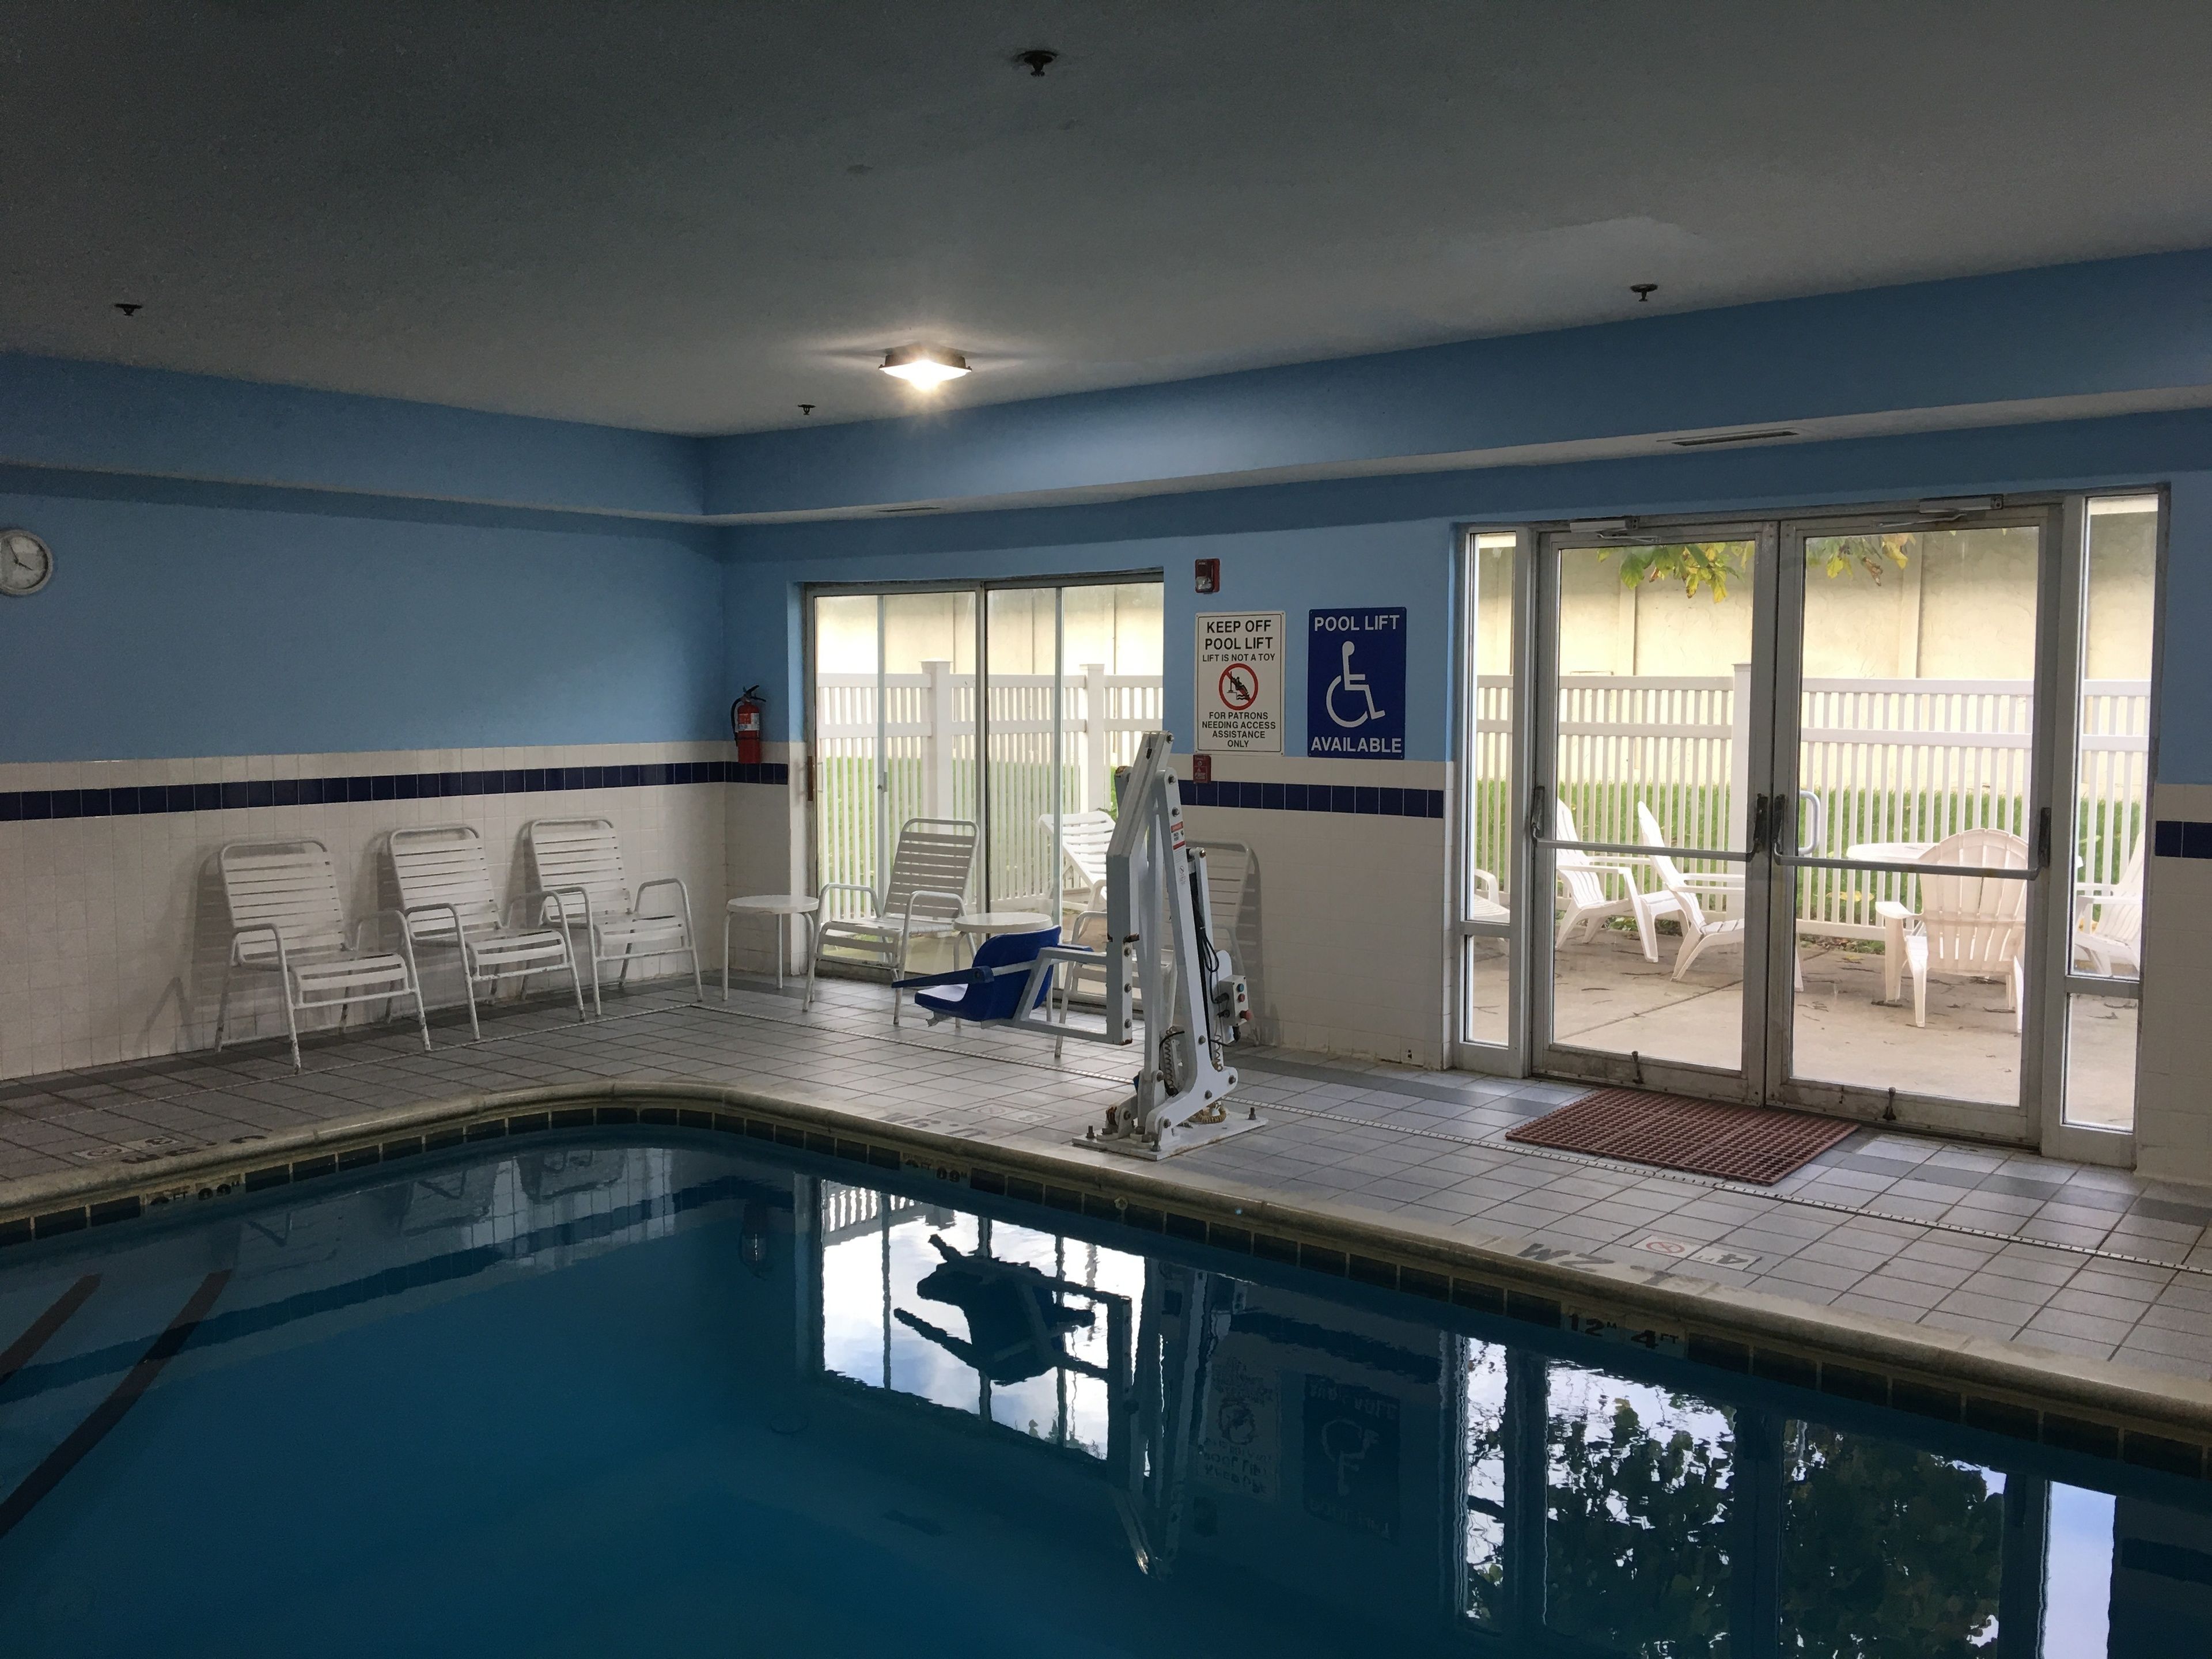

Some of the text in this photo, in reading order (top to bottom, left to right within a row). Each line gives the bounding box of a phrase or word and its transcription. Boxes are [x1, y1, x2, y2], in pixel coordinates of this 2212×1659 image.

[1207, 619, 1271, 633] KEEP OFF
[1314, 615, 1400, 631] POOL LIFT
[1205, 637, 1273, 650] POOL LIFT
[1232, 654, 1249, 662] NOT
[1258, 653, 1275, 661] TOY
[1209, 711, 1226, 719] FOR
[1240, 721, 1276, 729] ACCESS
[1212, 730, 1266, 738] ASSISTANCE
[1310, 736, 1402, 753] AVAILABLE
